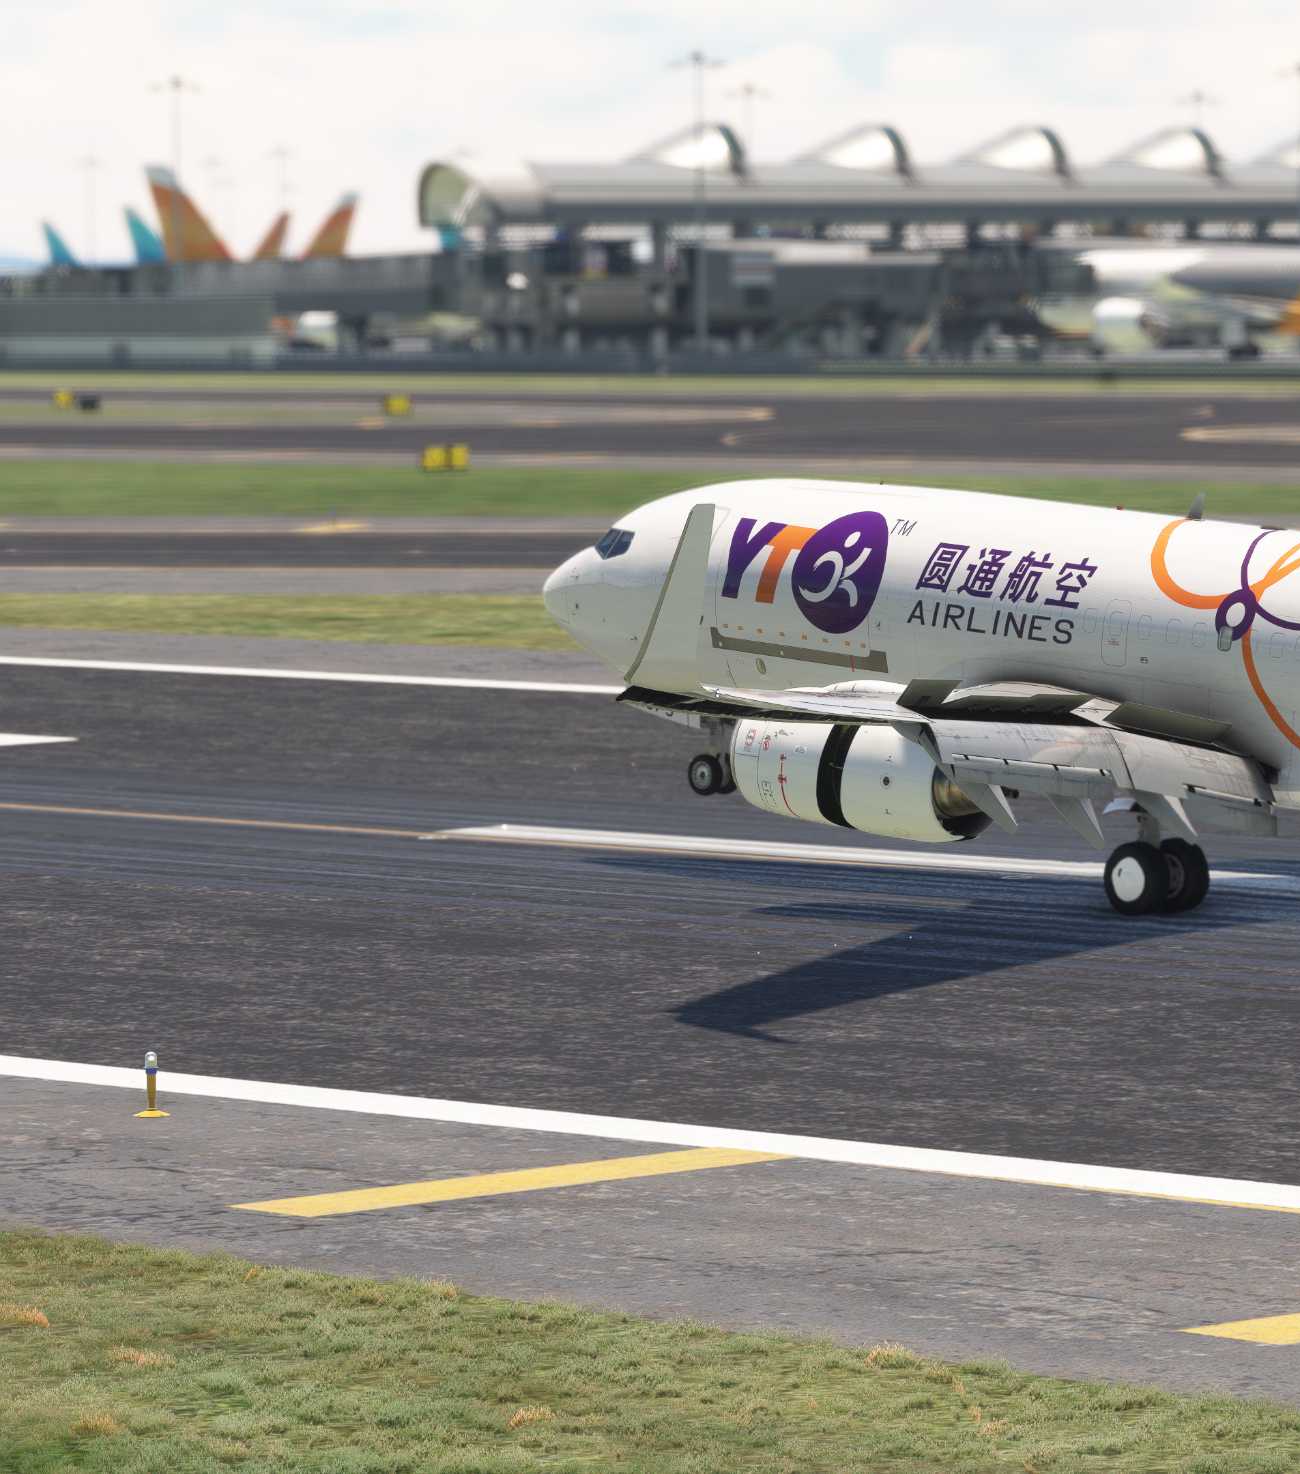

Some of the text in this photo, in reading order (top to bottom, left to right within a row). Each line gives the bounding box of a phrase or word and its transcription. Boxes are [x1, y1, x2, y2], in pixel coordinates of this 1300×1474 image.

[890, 518, 918, 537] TM
[915, 542, 1098, 609] 圆通航空
[907, 599, 1075, 645] AIRLINES
